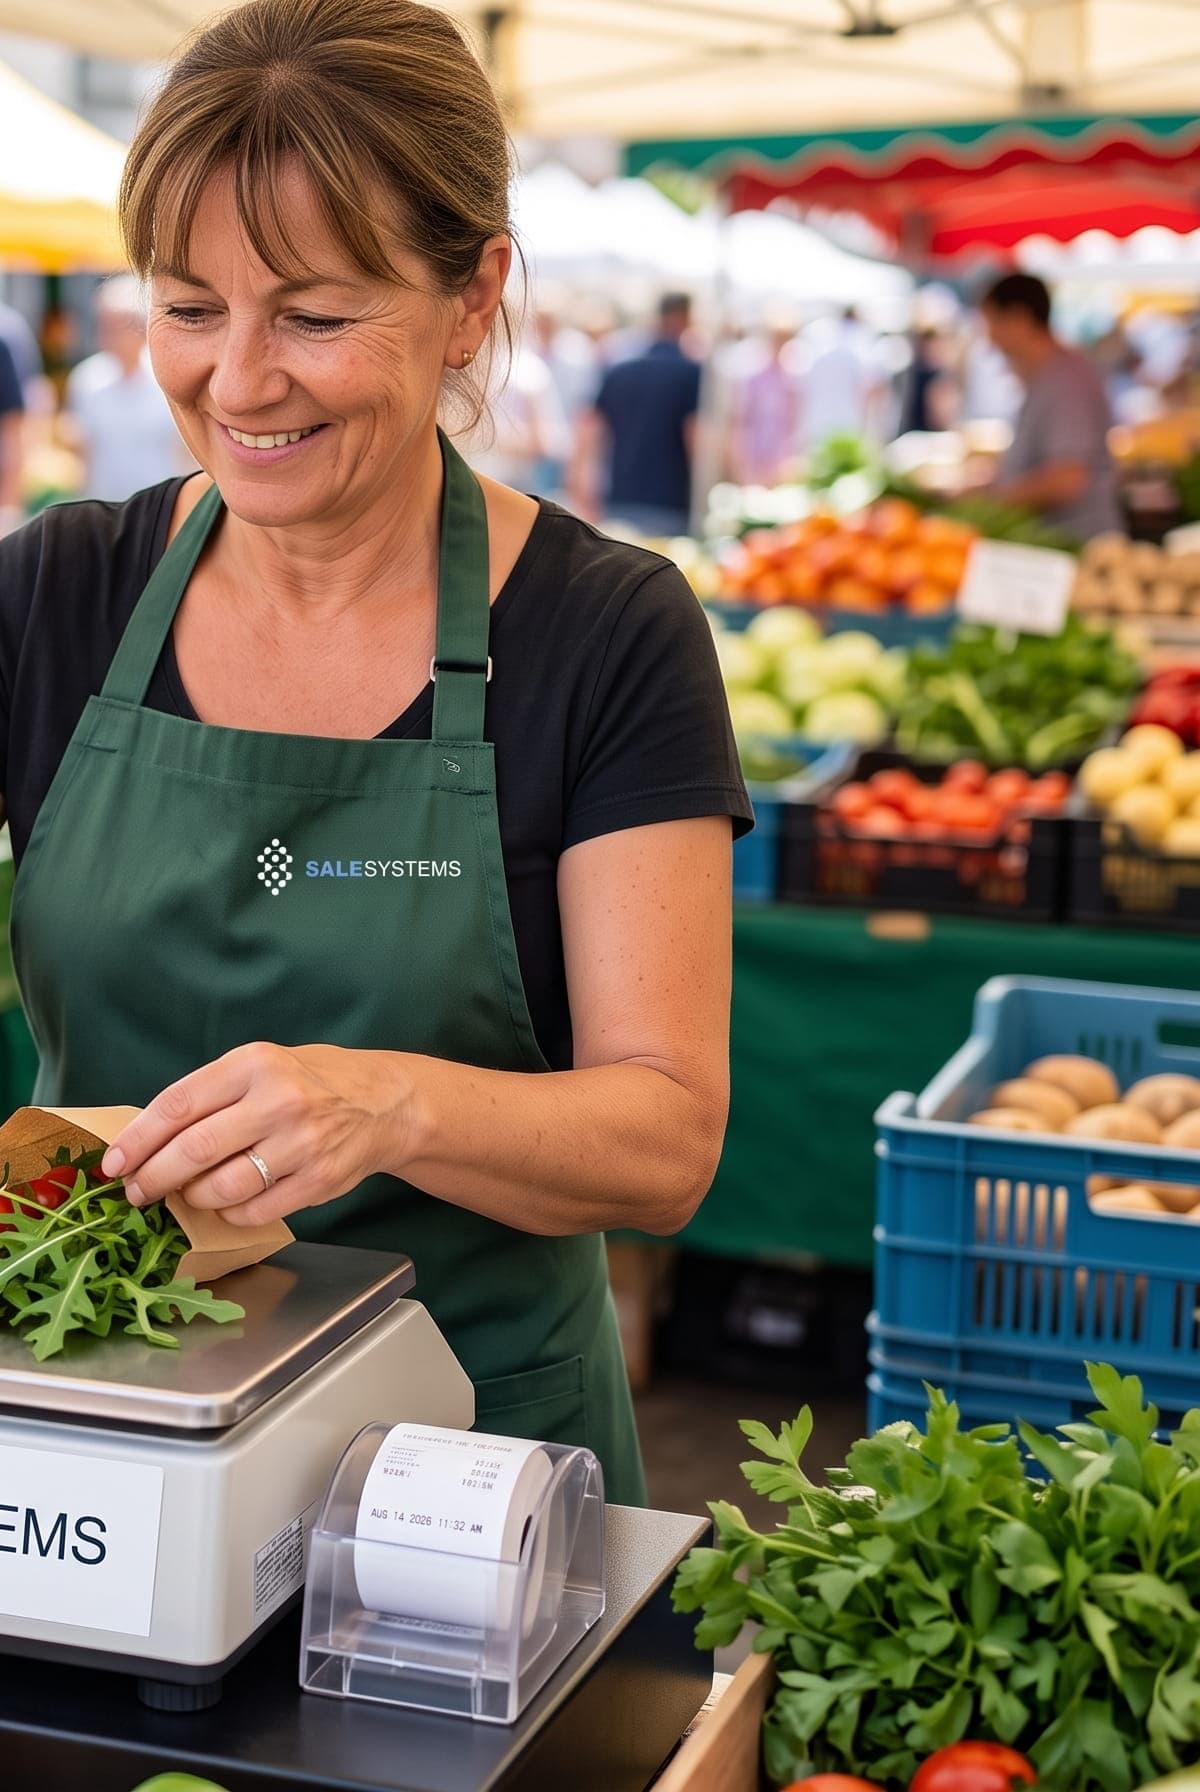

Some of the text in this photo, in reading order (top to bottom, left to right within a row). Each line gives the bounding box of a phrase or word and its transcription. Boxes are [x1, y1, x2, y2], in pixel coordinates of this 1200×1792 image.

[305, 860, 461, 878] SALESYSTEMS
[394, 1511, 405, 1521] 14
[409, 1513, 432, 1526] 2026
[439, 1518, 466, 1531] 11:32
[470, 1524, 484, 1534] AM
